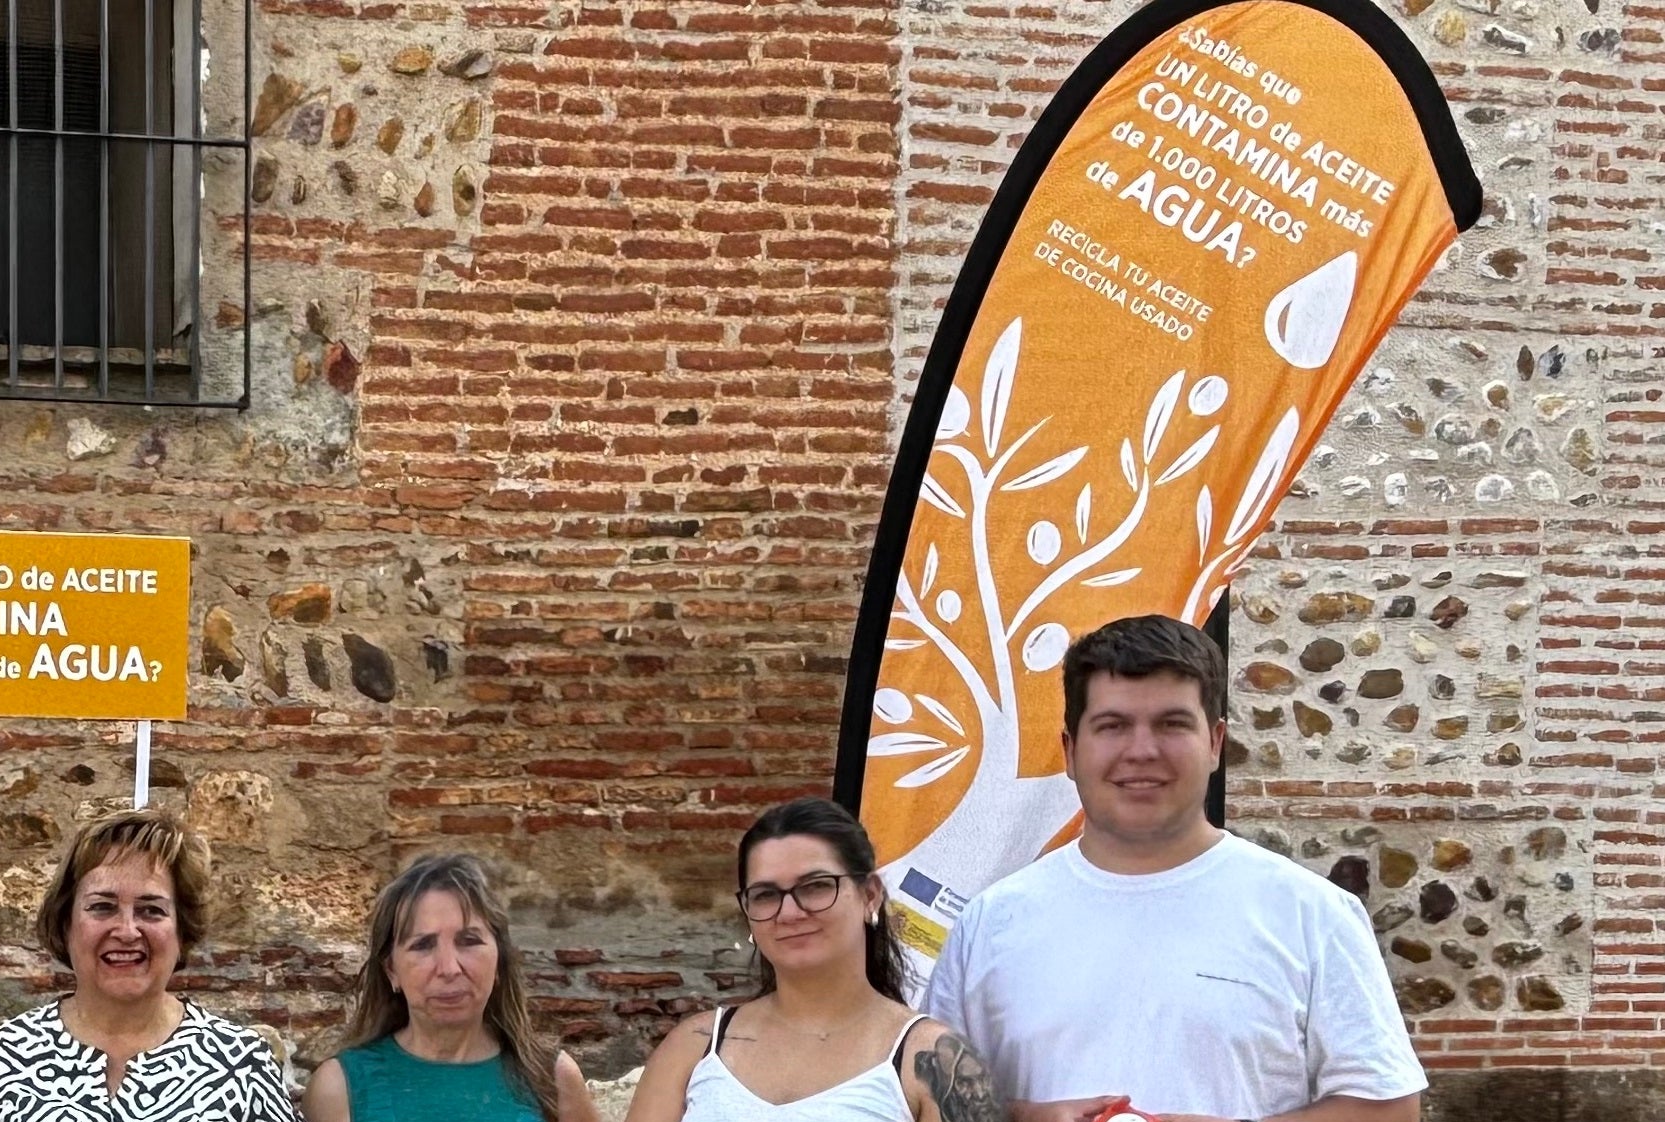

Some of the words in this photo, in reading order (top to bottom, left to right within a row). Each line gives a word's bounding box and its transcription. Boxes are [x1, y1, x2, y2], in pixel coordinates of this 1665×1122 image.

[1178, 24, 1257, 80] ¿Sabías
[1259, 69, 1301, 106] que
[1137, 82, 1318, 208] CONTAMINA
[1319, 194, 1374, 238] más
[1154, 54, 1196, 89] UN
[1194, 70, 1270, 130] LITRO
[1269, 121, 1301, 153] de
[1303, 141, 1396, 205] ACEITE
[1086, 160, 1119, 193] de
[1118, 170, 1257, 270] AGUA?
[1112, 120, 1145, 150] de
[1147, 135, 1217, 191] 1.000
[1217, 179, 1308, 244] LITROS
[1034, 242, 1061, 267] DE
[1061, 258, 1128, 313] COCINA
[1129, 297, 1194, 343] USADO
[1047, 220, 1121, 273] RECICLA
[1123, 263, 1149, 288] TU
[1146, 278, 1214, 324] ACEITE
[21, 567, 54, 591] de
[61, 568, 158, 594] ACEITE
[28, 644, 162, 683] AGUA?
